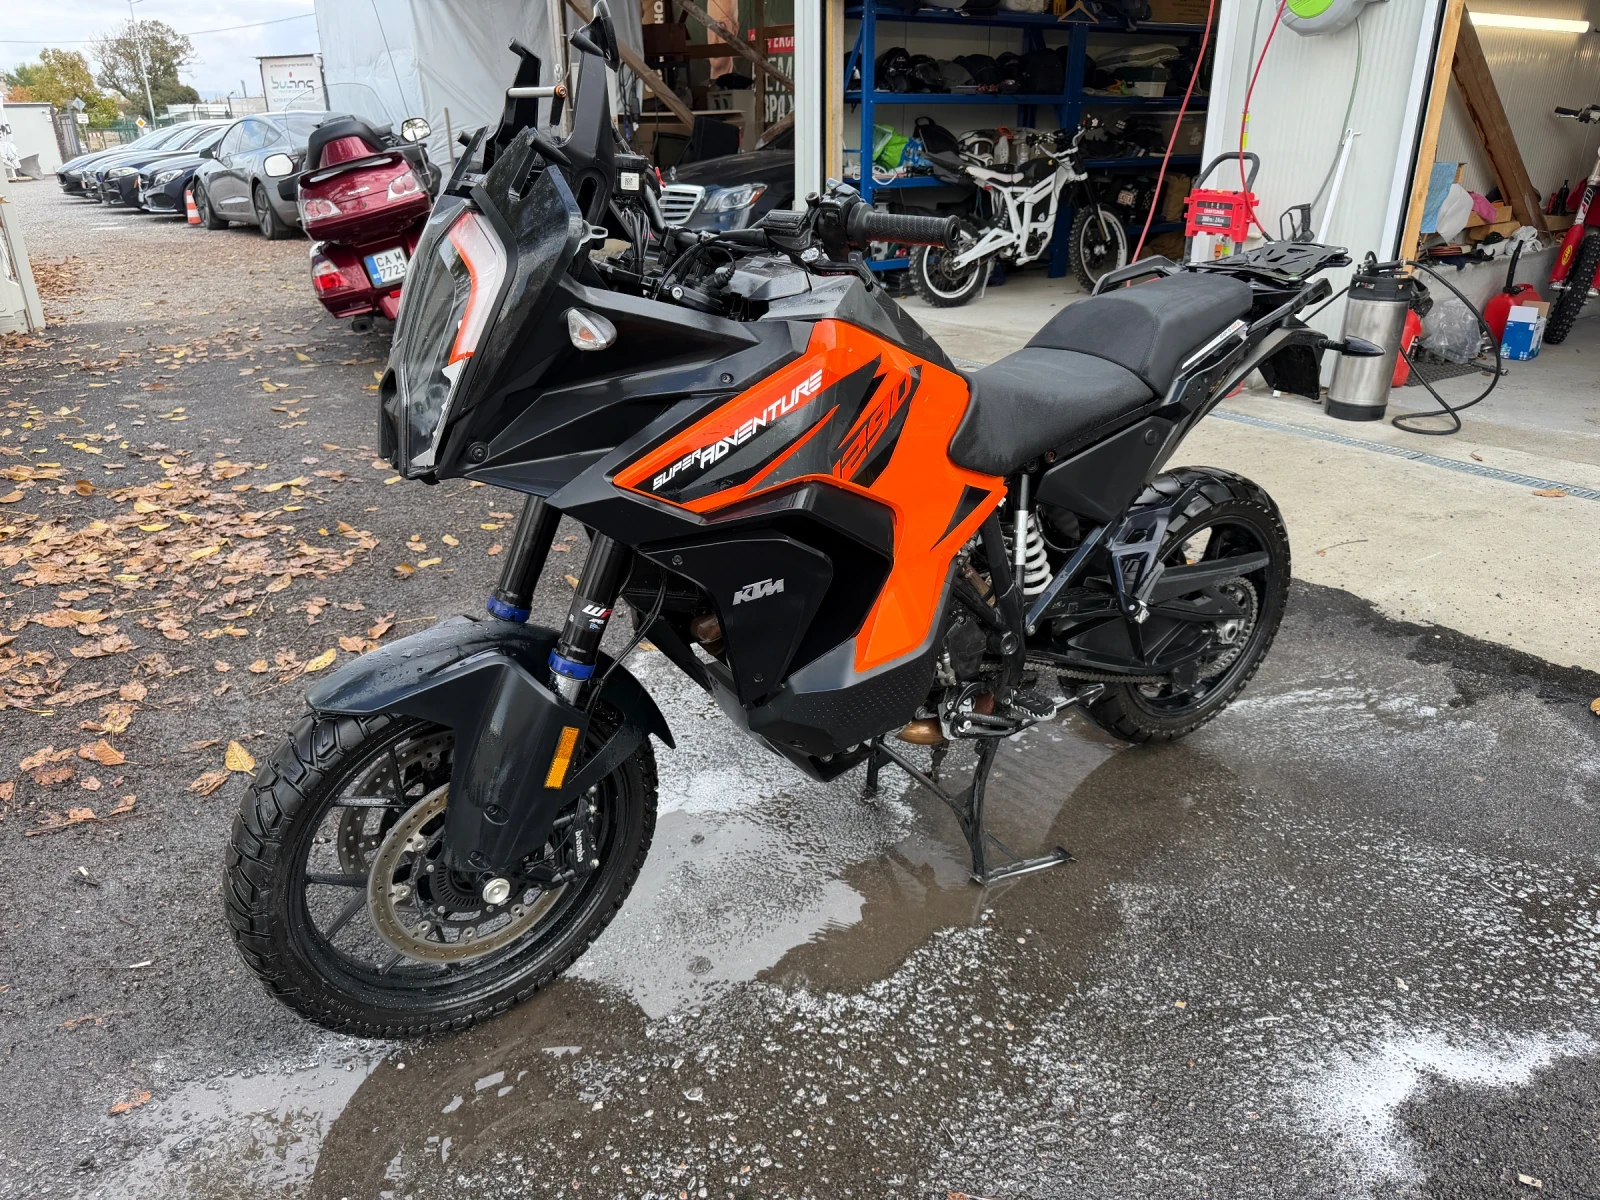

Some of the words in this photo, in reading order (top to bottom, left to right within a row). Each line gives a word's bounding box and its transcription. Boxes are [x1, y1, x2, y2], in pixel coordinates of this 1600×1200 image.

[376, 255, 393, 267] CA
[380, 263, 407, 279] 7723
[652, 448, 701, 491] SUPER
[700, 368, 823, 470] ADVENTURE
[832, 373, 912, 481] 1290
[732, 577, 785, 606] KTM
[574, 829, 585, 863] brembo
